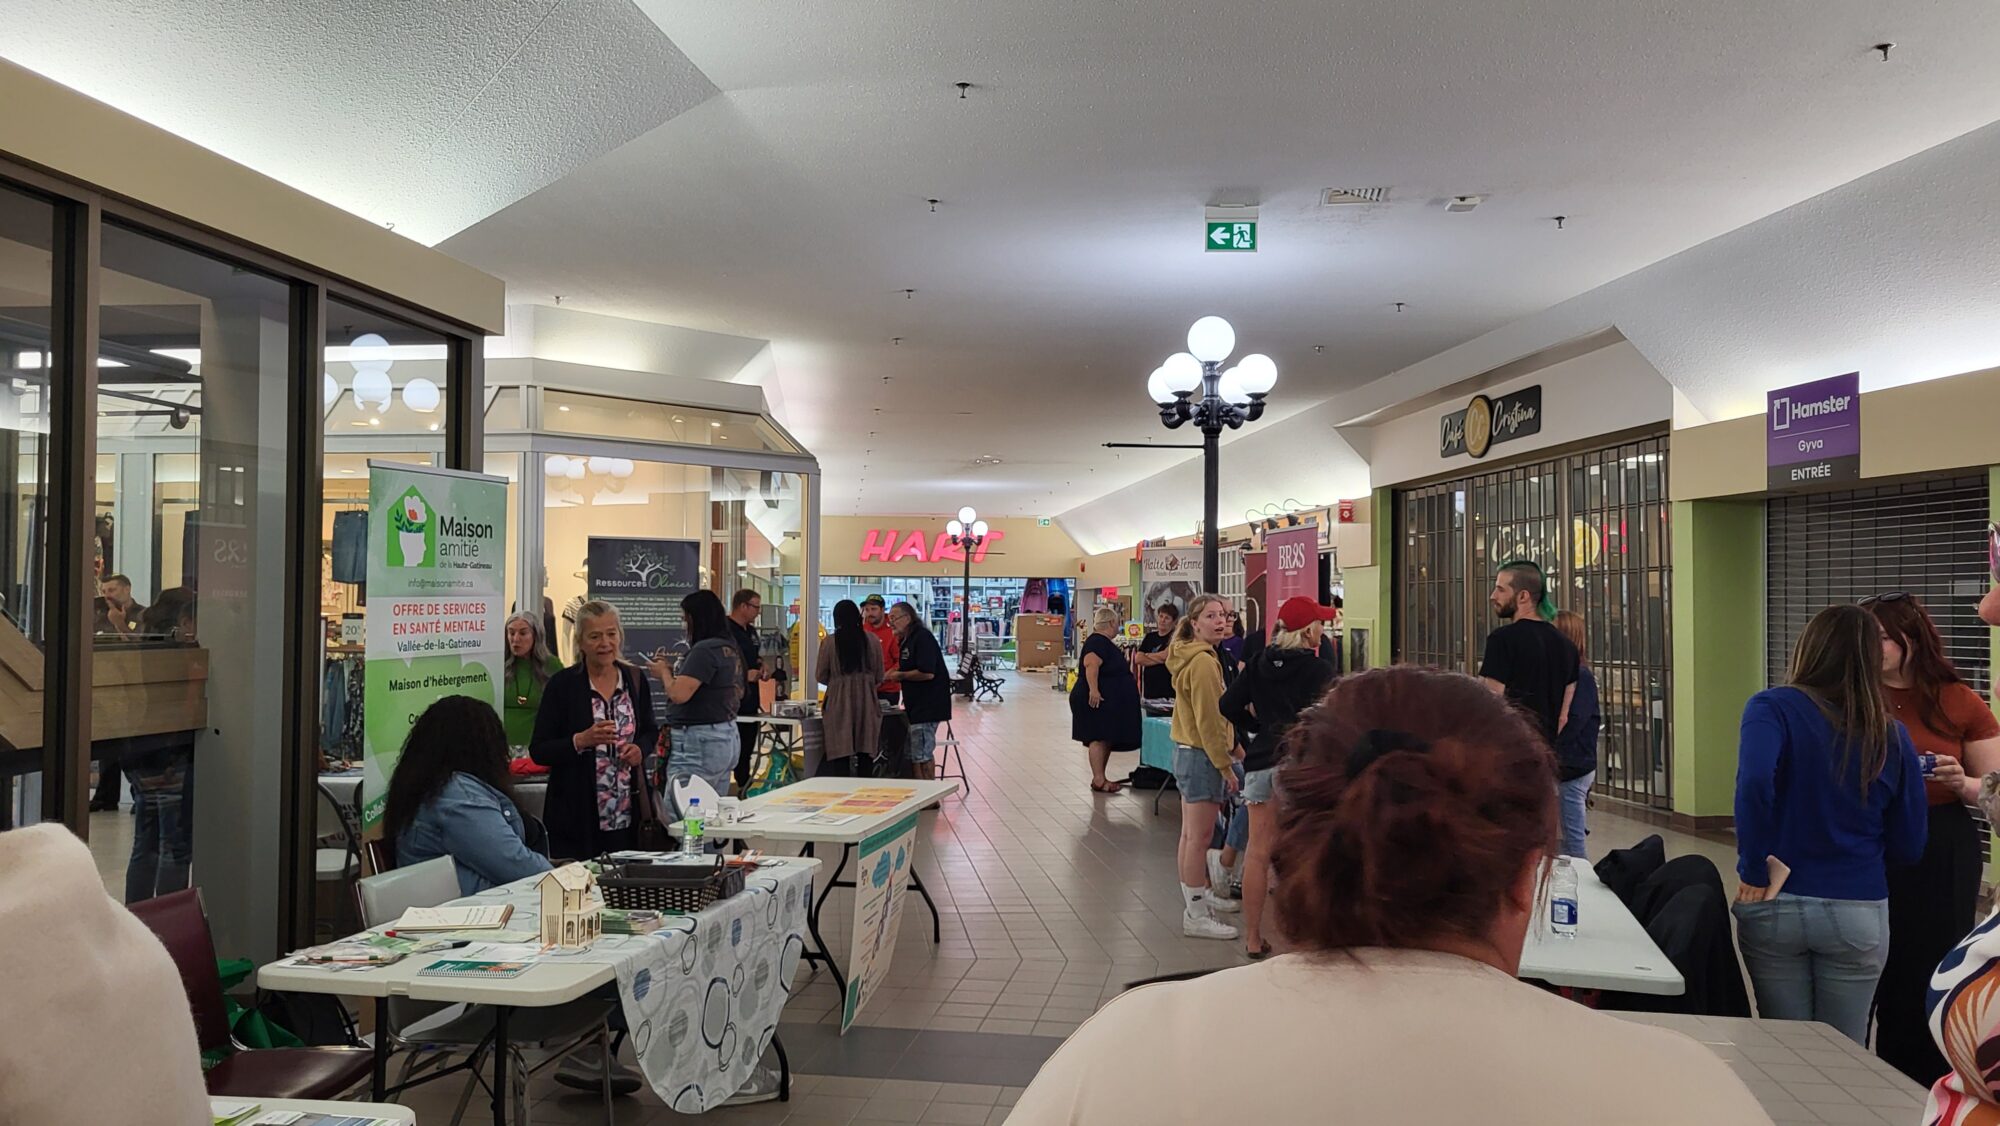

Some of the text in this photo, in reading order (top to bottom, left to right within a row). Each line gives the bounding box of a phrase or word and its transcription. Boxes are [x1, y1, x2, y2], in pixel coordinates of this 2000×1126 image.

[1791, 395, 1851, 420] Hamster
[1441, 400, 1537, 451] Café Cristina
[1798, 439, 1823, 453] Gyva
[1791, 462, 1831, 481] ENTRÉE
[439, 516, 493, 540] Maison
[439, 539, 479, 557] amitié
[860, 529, 1004, 563] HART
[595, 572, 694, 589] Ressources Olivier
[393, 603, 486, 616] OFFRE DE SERVICES
[393, 620, 486, 635] EN SANTÉ MENTALE
[397, 638, 481, 652] Vallée-de-la-Gatineau
[389, 672, 487, 692] Maison d'hébergement
